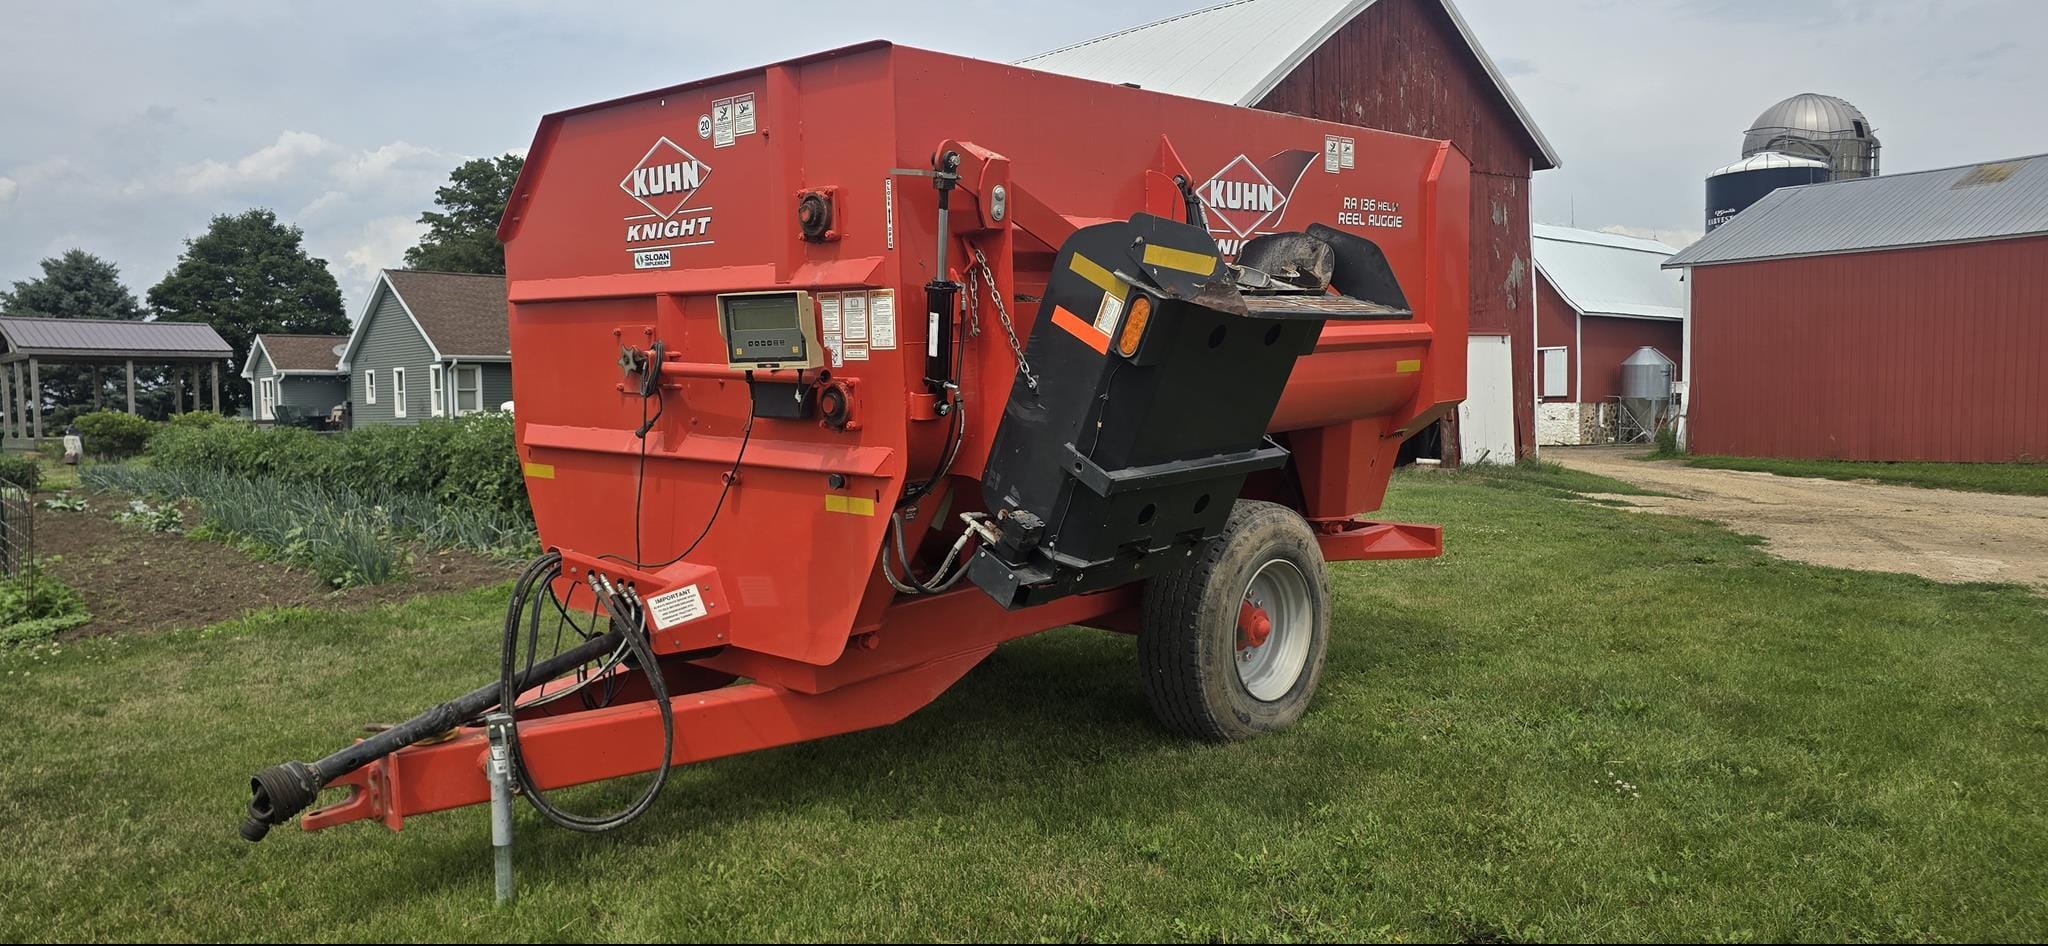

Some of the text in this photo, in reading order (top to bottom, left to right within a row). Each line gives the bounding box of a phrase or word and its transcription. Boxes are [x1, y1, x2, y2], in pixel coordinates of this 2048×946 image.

[700, 120, 710, 130] 20
[633, 160, 700, 198] KUHN
[1210, 179, 1273, 212] KUHN
[1343, 197, 1357, 210] RA
[1360, 198, 1376, 212] 136
[1338, 212, 1403, 228] REEL AUGGIE
[626, 217, 711, 242] KNIGHT
[644, 253, 669, 262] SLOAN
[654, 588, 691, 604] IMPORTANT
